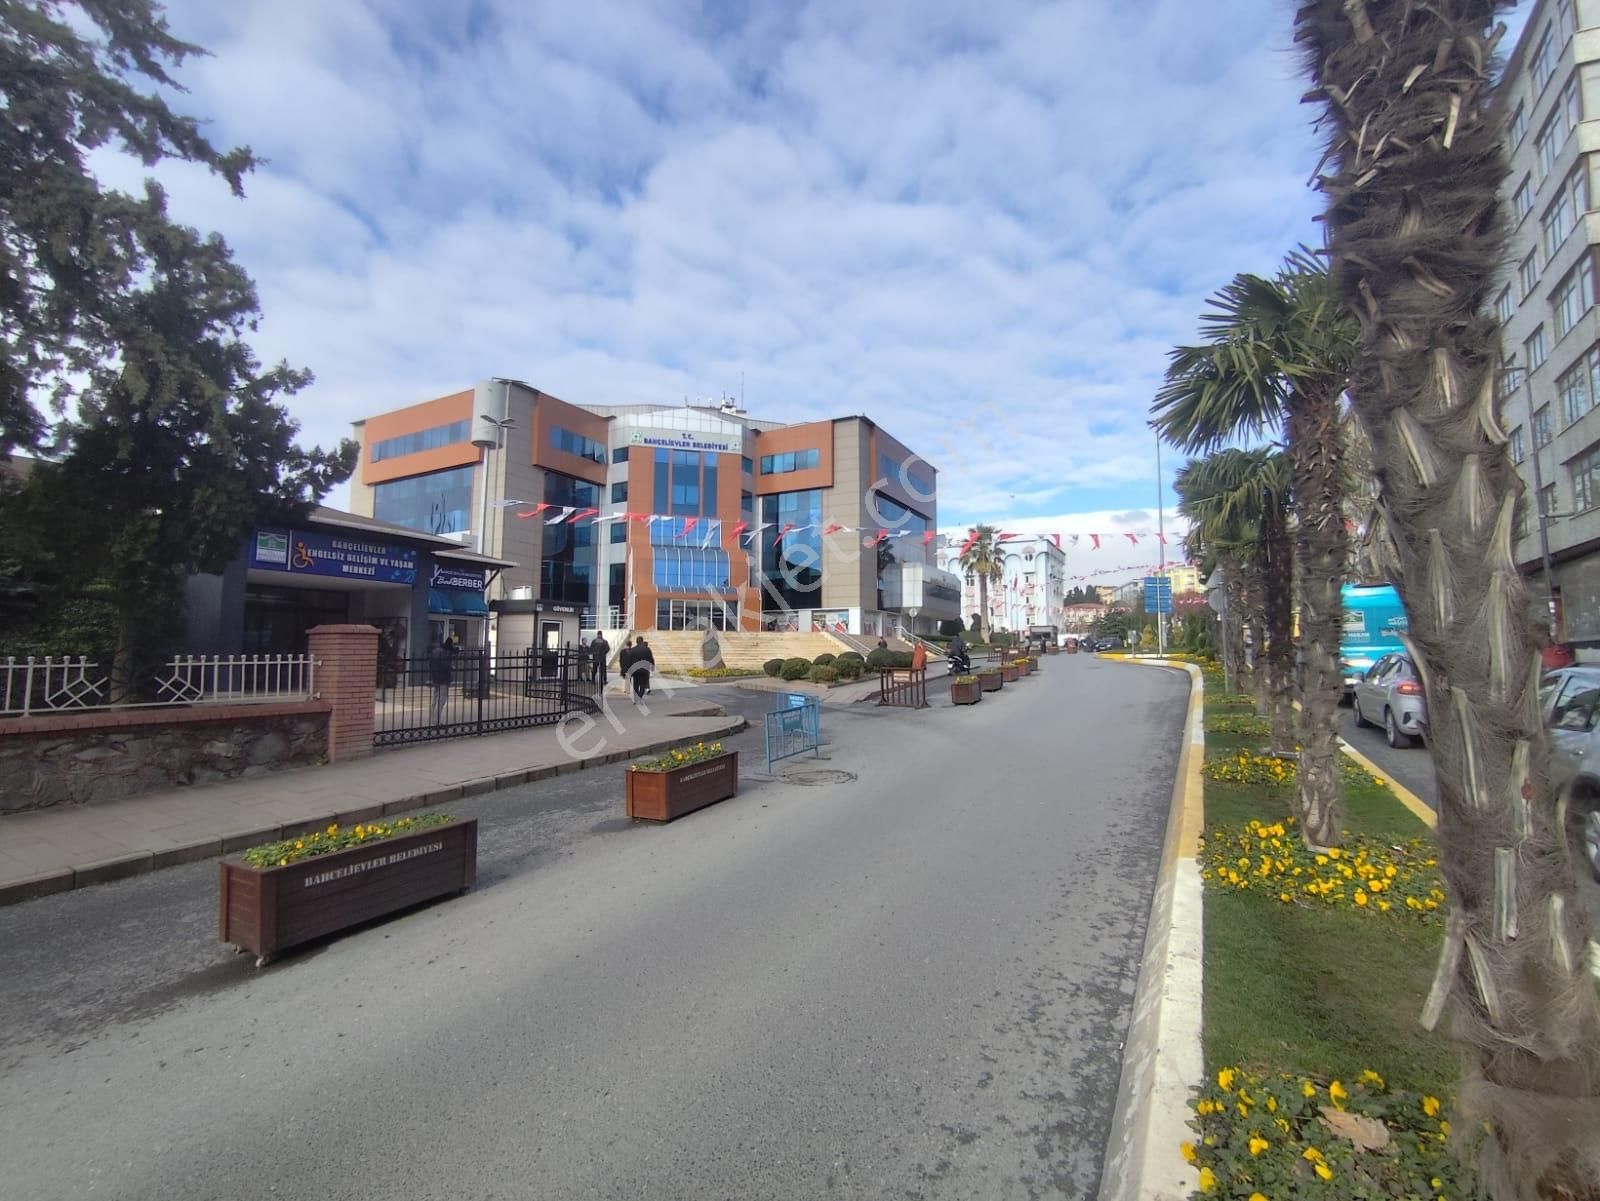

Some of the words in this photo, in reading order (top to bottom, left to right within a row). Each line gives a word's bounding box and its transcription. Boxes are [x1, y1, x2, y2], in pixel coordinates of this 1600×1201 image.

[332, 540, 386, 554] BAHÇELİEVLER
[307, 548, 344, 561] ENGELSİZ
[347, 553, 378, 565] GELİŞİM
[380, 558, 389, 566] VE
[391, 560, 414, 569] YAŞAM
[342, 564, 376, 576] MERKEZİ
[452, 577, 483, 588] BERBER
